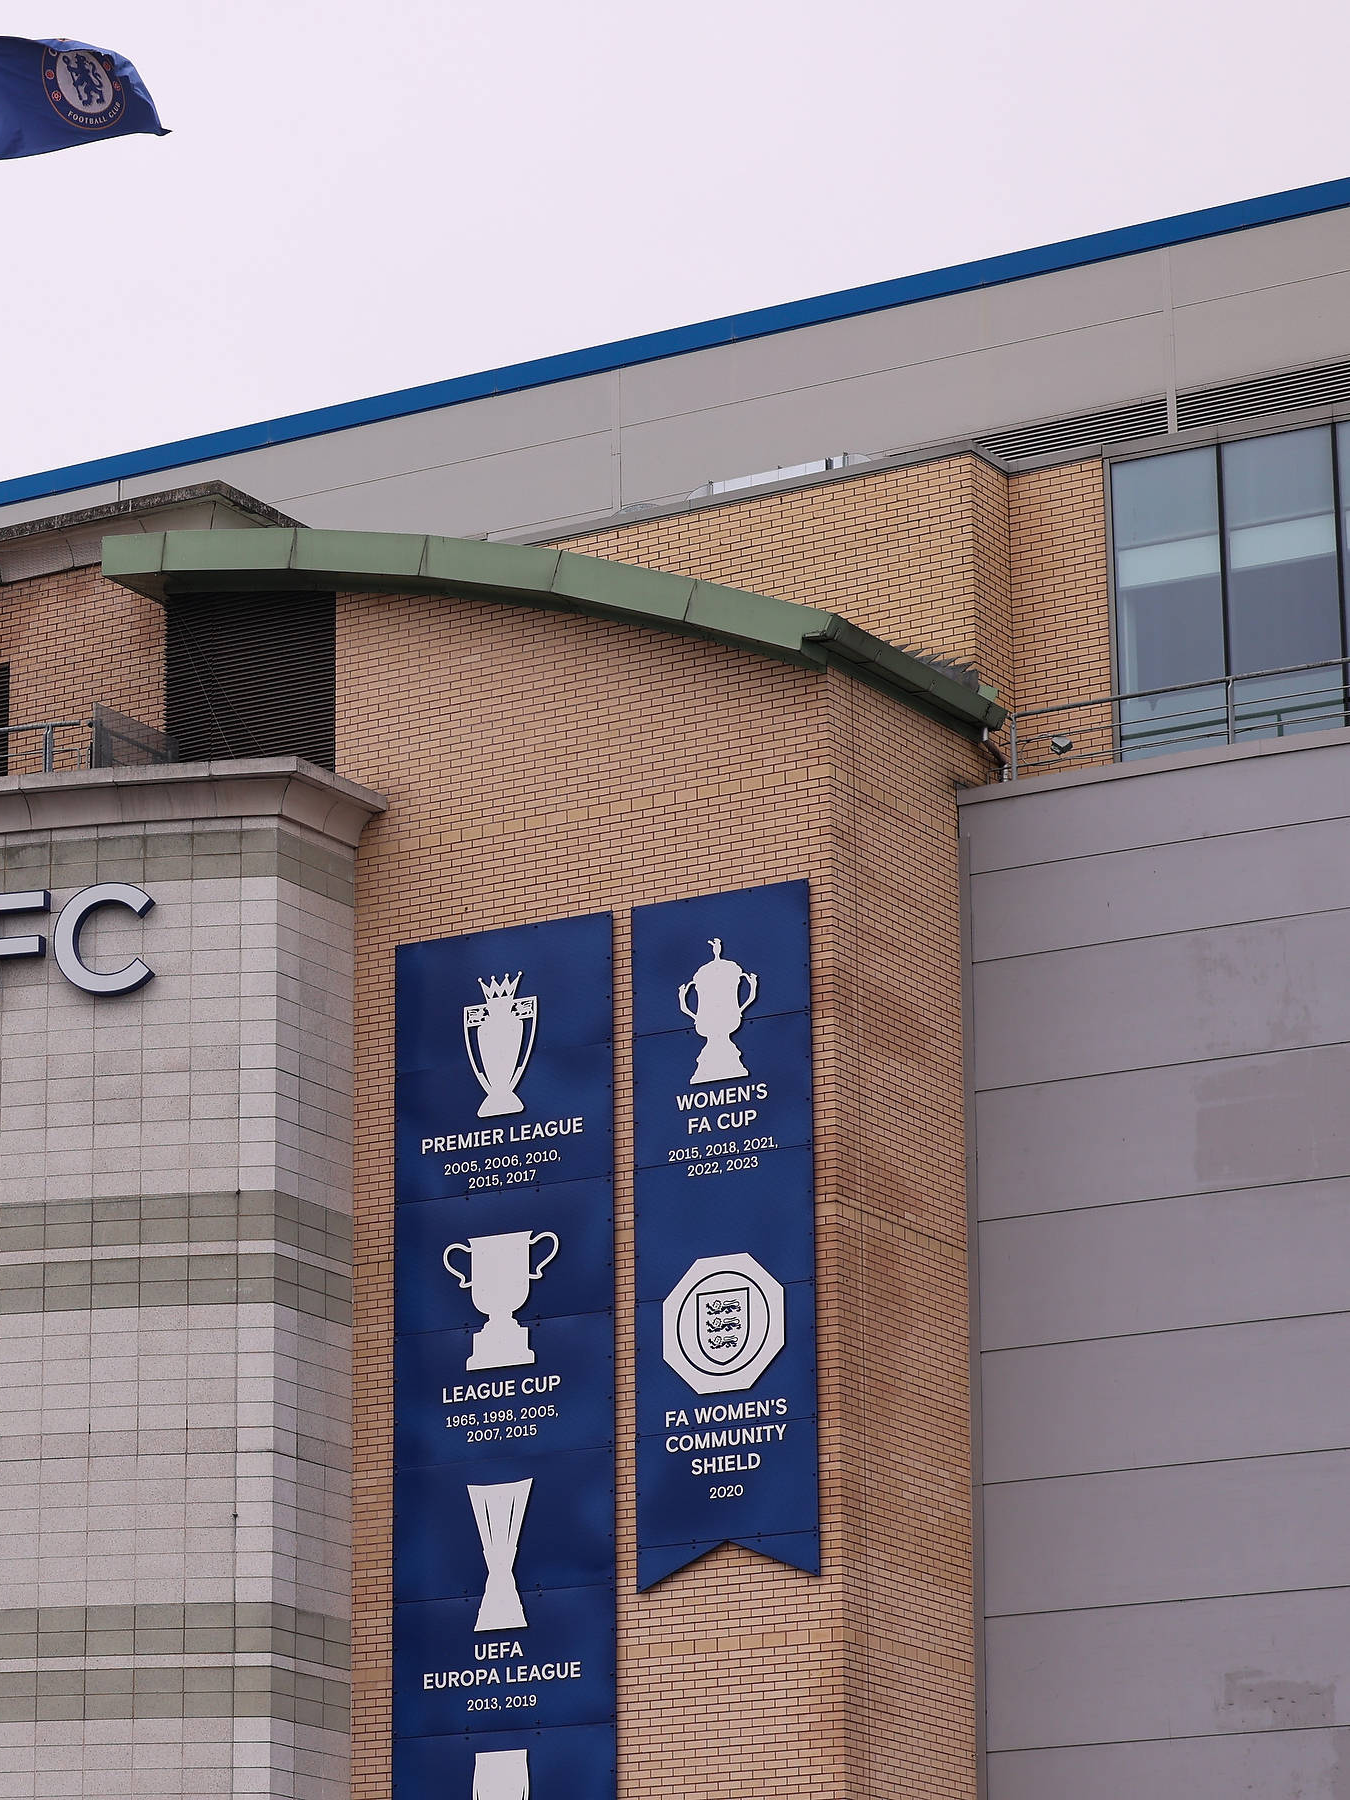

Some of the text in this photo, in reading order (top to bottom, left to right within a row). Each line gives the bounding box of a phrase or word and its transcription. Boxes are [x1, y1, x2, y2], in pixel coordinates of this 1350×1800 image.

[67, 101, 122, 125] FOOTBALL CLUB
[676, 1082, 768, 1111] WOMEN'S
[688, 1109, 757, 1135] FA CUP
[421, 1116, 583, 1155] PREMIER LEAGUE
[668, 1136, 779, 1162] 2015, 2018, 2021,
[444, 1149, 561, 1176] 2005, 2006, 2010,
[687, 1155, 759, 1177] 2022, 2023
[468, 1169, 537, 1189] 2015, 2017
[442, 1375, 561, 1404] LEAGUE CUP
[445, 1404, 559, 1428] 1965, 1998, 2005,
[665, 1397, 788, 1428] FA WOMEN'S
[466, 1423, 538, 1443] 2007, 2015
[665, 1423, 787, 1453] COMMUNITY
[691, 1452, 761, 1476] SHIELD
[709, 1484, 744, 1499] 2020
[474, 1641, 524, 1661] UEFA
[423, 1661, 581, 1690] EUROPA LEAGUE
[467, 1694, 537, 1712] 2013, 2019
